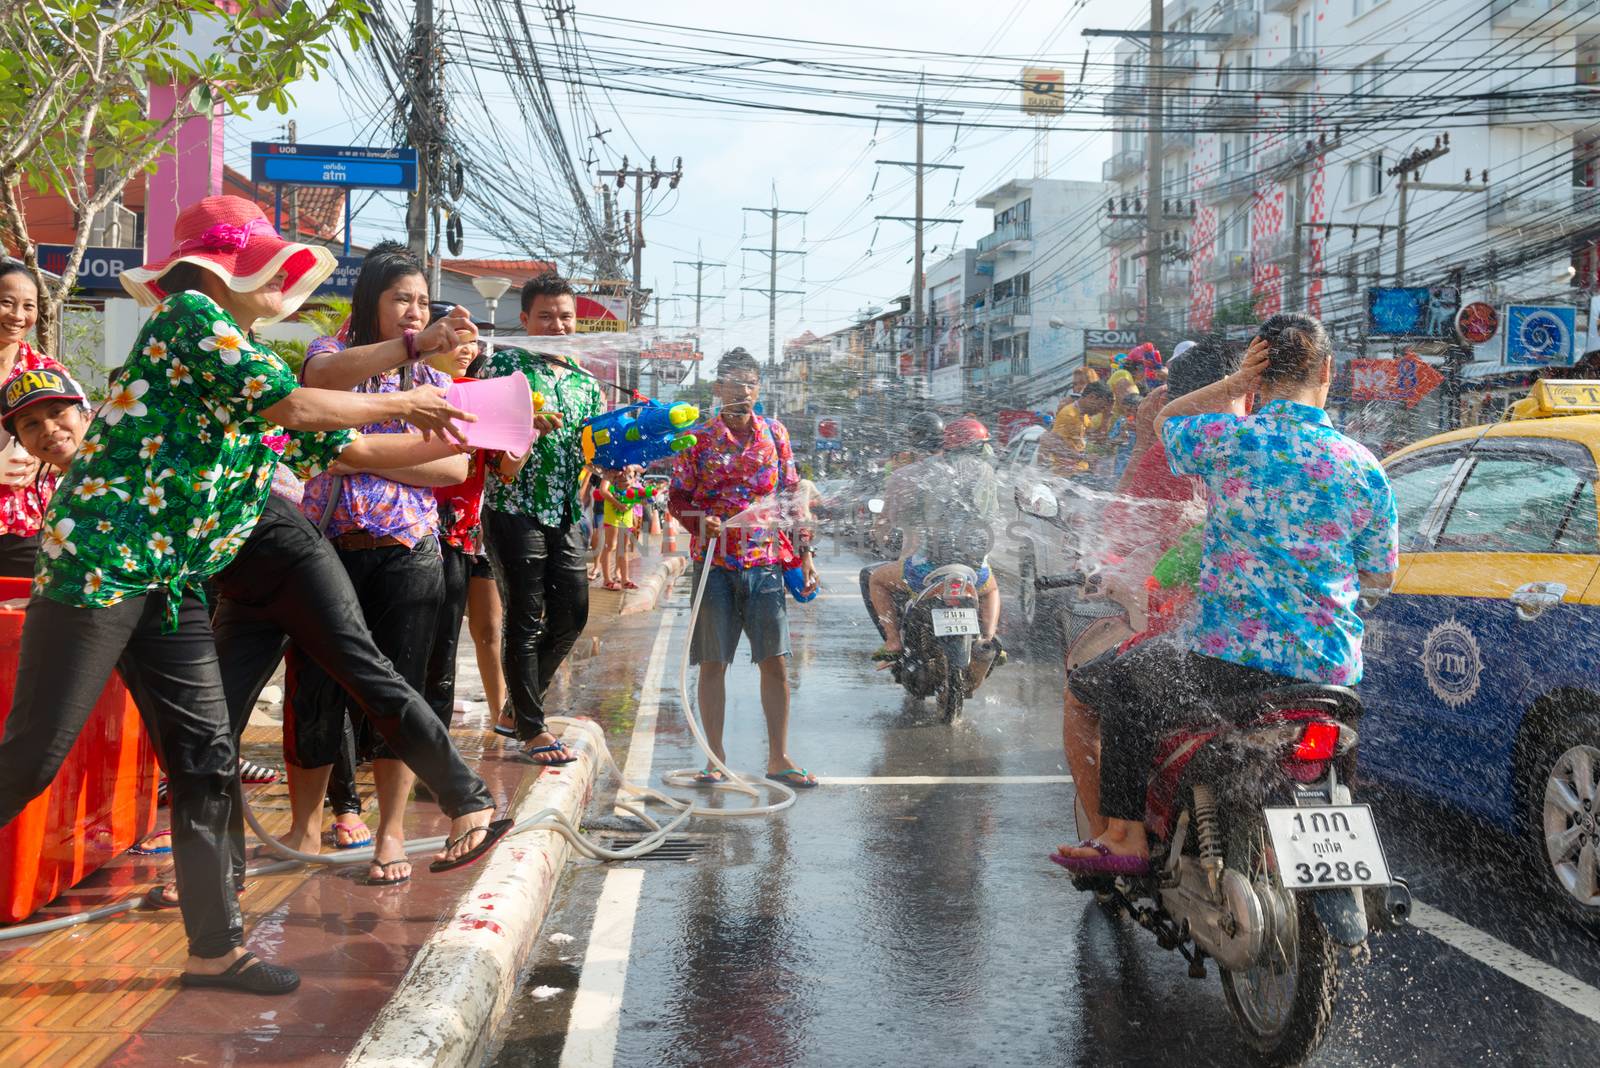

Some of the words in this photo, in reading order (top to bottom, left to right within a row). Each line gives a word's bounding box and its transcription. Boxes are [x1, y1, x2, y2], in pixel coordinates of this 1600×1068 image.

[279, 146, 297, 155] UOB
[323, 170, 346, 180] atm
[1088, 331, 1136, 343] SOM
[1398, 360, 1418, 391] 8
[1436, 652, 1467, 675] PTM
[1295, 861, 1372, 884] 3286
